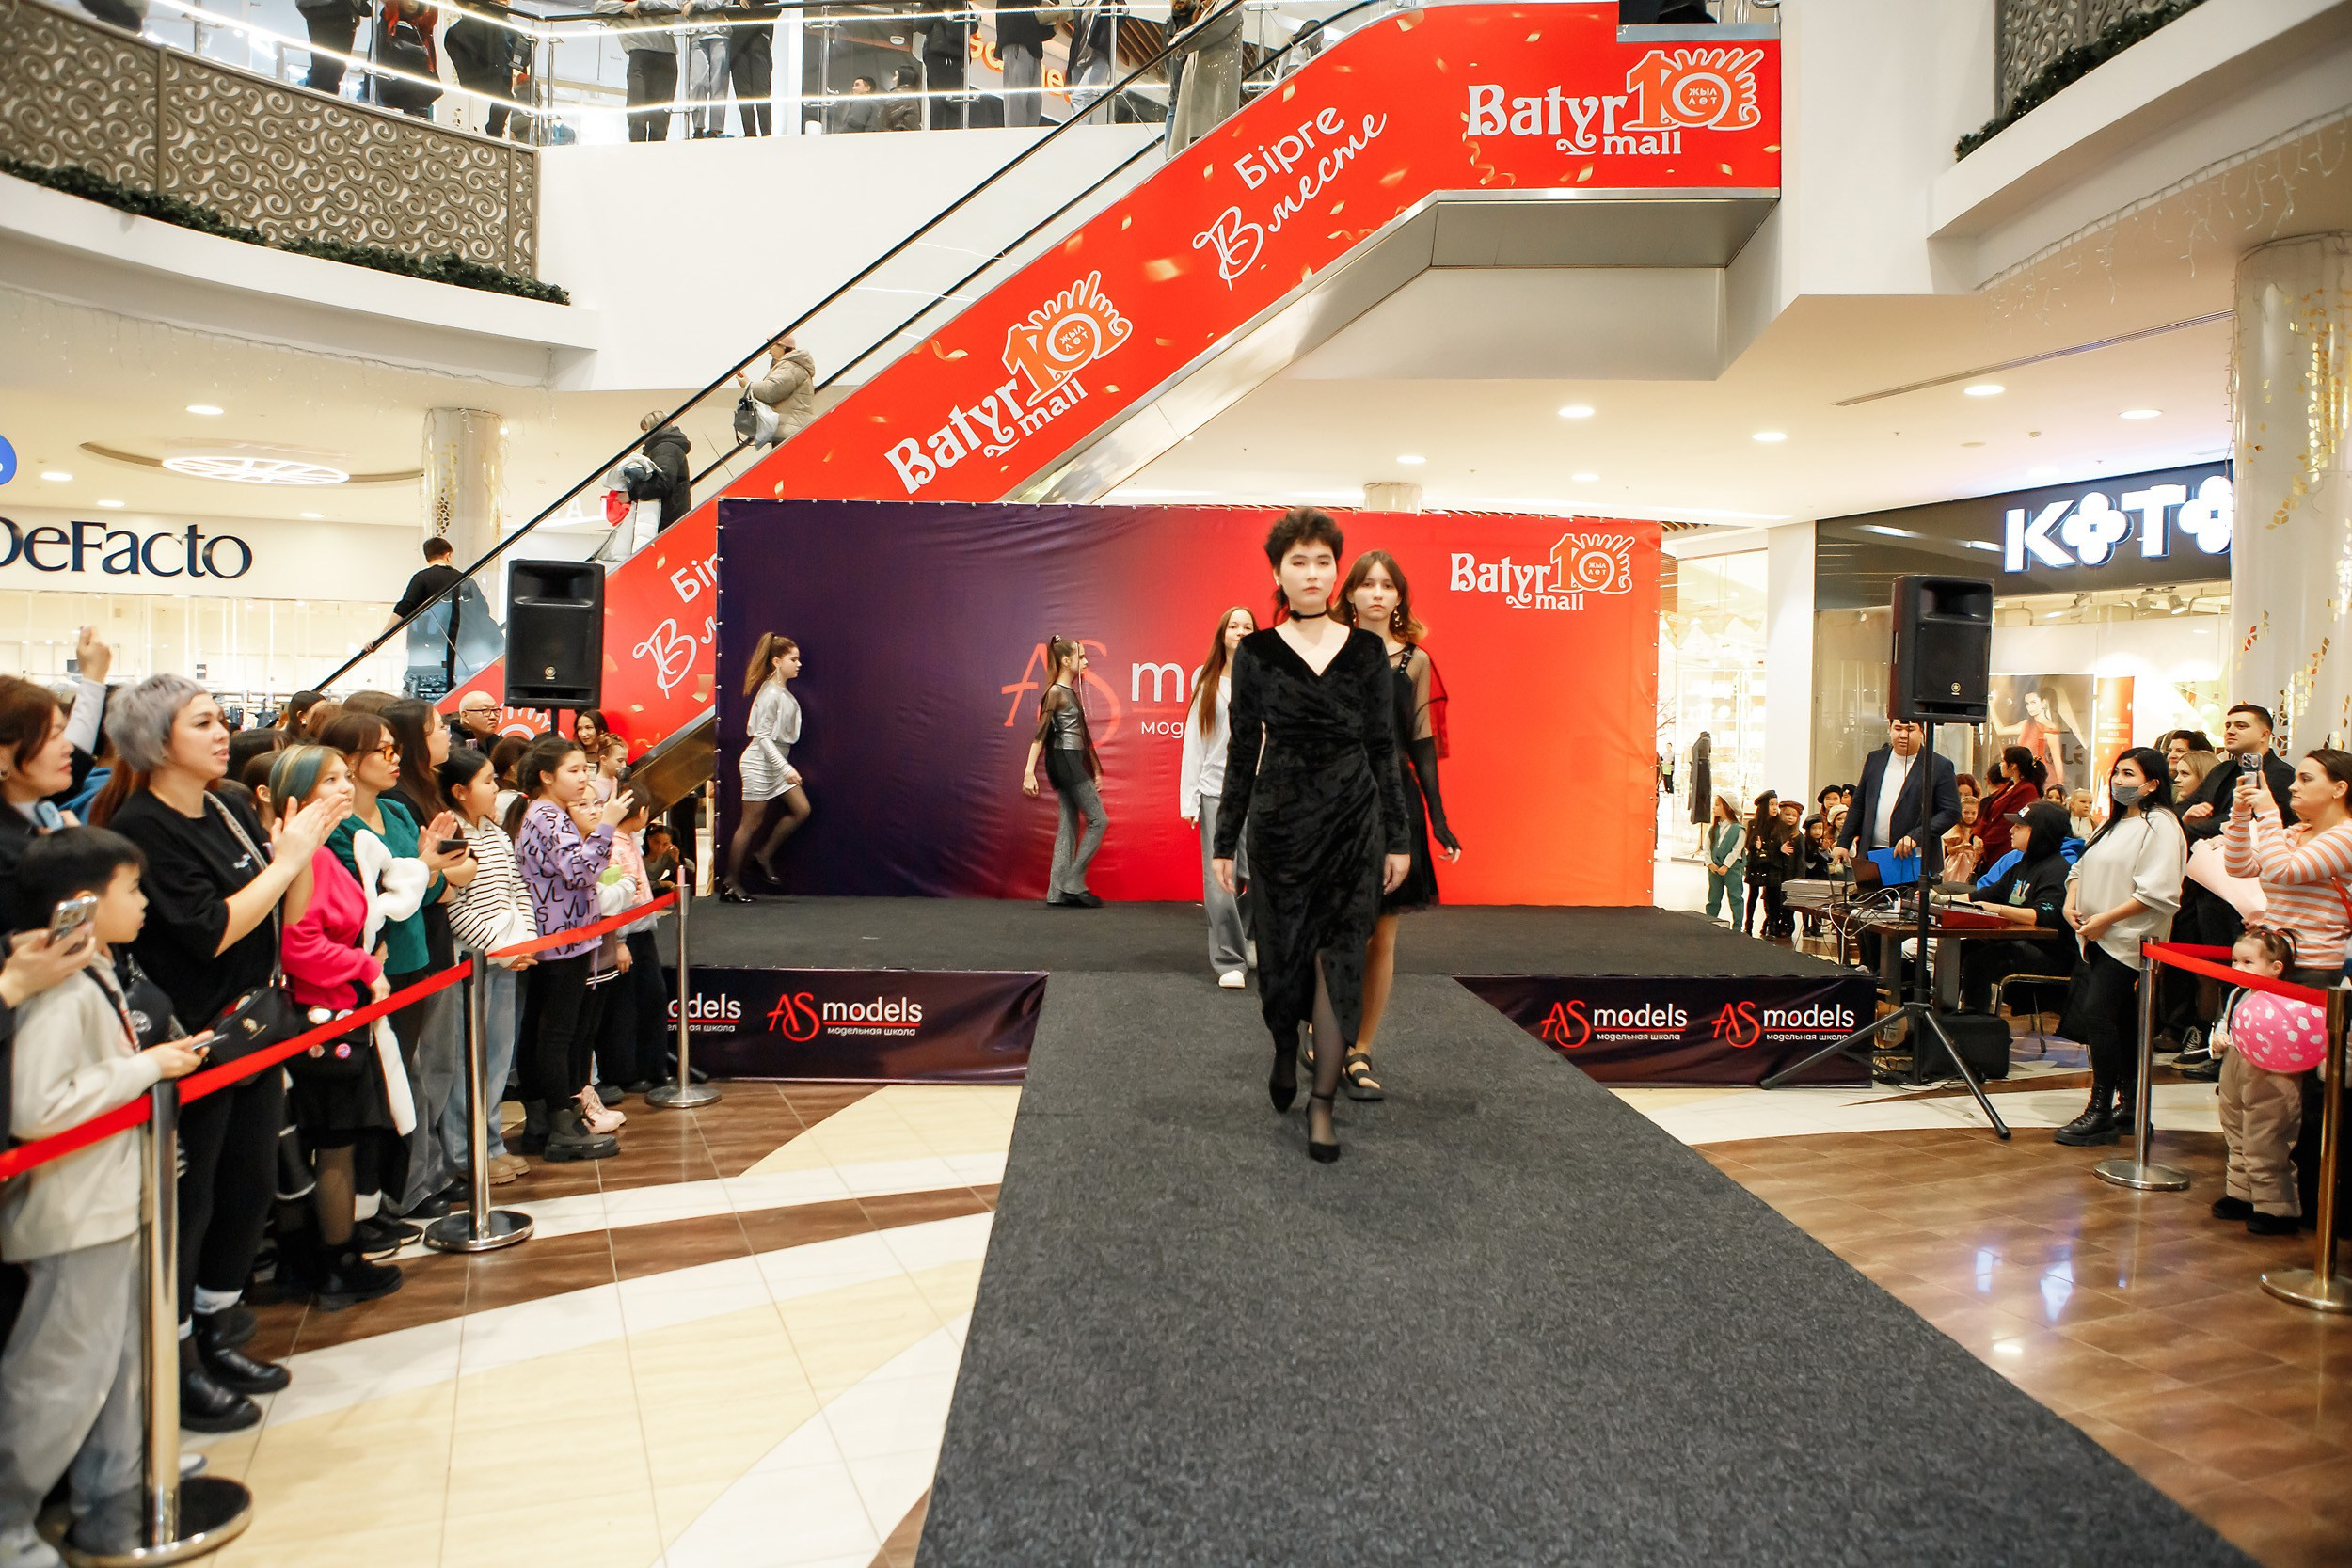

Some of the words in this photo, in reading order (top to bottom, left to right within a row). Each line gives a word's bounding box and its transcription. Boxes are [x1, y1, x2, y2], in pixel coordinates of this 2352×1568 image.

[1467, 84, 1628, 156] Batyr
[1603, 131, 1682, 155] mall
[1233, 107, 1345, 190] Бірге
[1192, 112, 1387, 291] Вместе
[1017, 377, 1089, 437] mall
[883, 378, 1025, 495] Batyr
[1450, 552, 1551, 609] Batyr
[1534, 593, 1584, 610] mall
[767, 991, 821, 1042] AS
[822, 996, 923, 1022] models
[883, 1027, 916, 1037] школа
[1540, 999, 1591, 1049] AS
[1593, 1003, 1689, 1028] models
[1649, 1033, 1681, 1041] школа
[1710, 1000, 1761, 1049] AS
[1763, 1003, 1855, 1028] models
